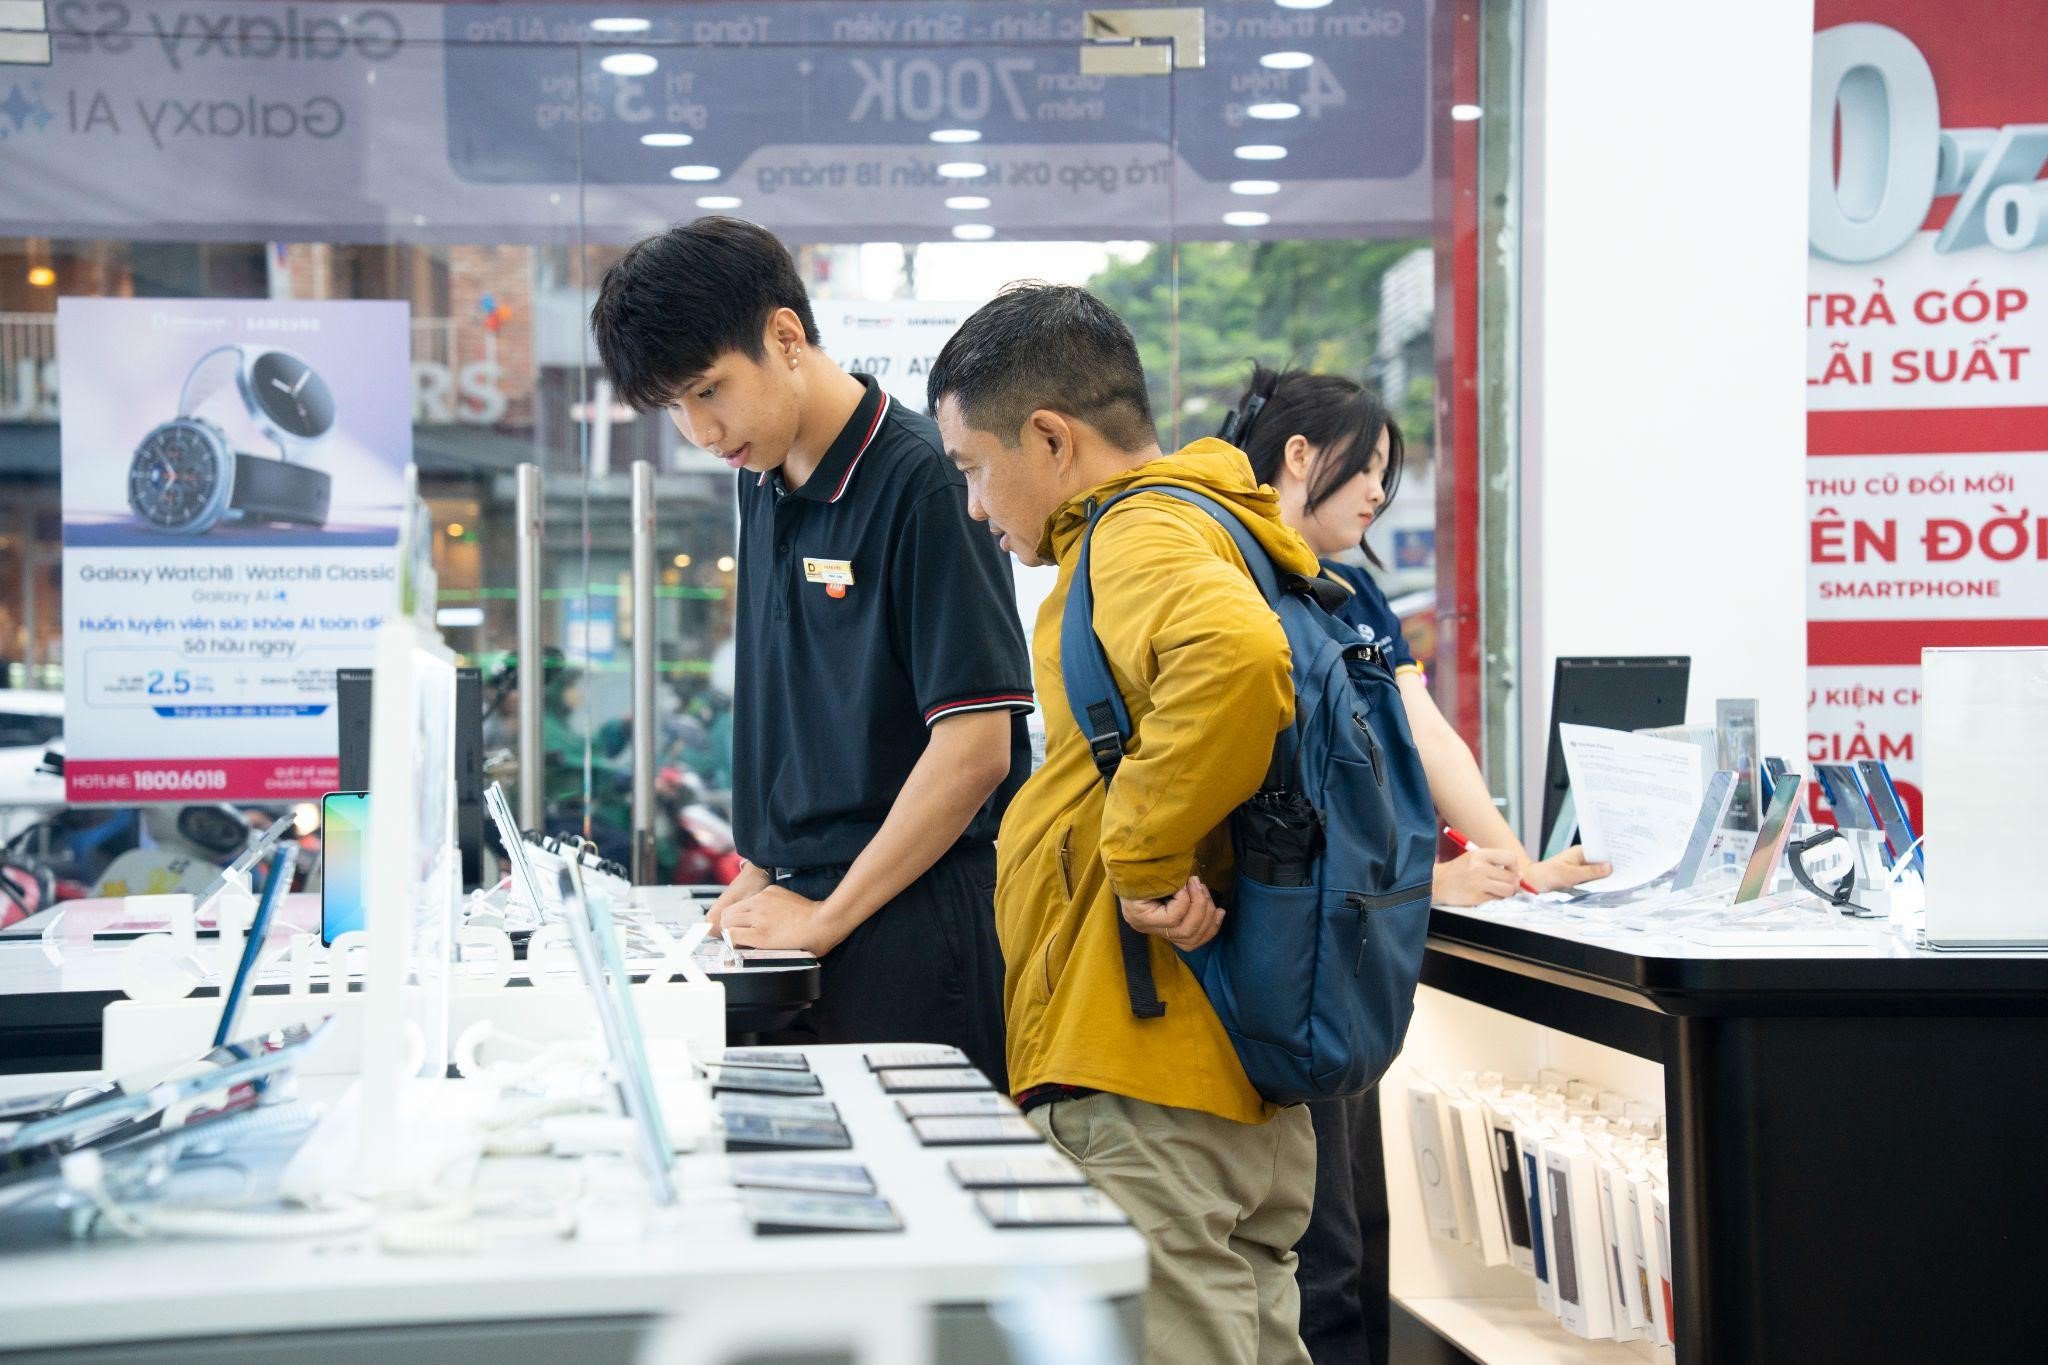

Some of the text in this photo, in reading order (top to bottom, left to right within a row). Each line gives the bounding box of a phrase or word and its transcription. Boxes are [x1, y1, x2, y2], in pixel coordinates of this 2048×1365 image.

[1914, 277, 2029, 325] GÓP
[1891, 333, 2031, 384] SUẤT
[1807, 478, 1856, 496] THU
[80, 564, 153, 585] Galaxy
[326, 563, 395, 581] Classic
[192, 588, 250, 604] Galaxy
[1819, 579, 2001, 599] SMARTPHONE
[249, 639, 296, 659] ngay
[147, 669, 191, 696] 2.5
[1825, 683, 1884, 708] KIỆN
[1807, 721, 1914, 762] GIẢM
